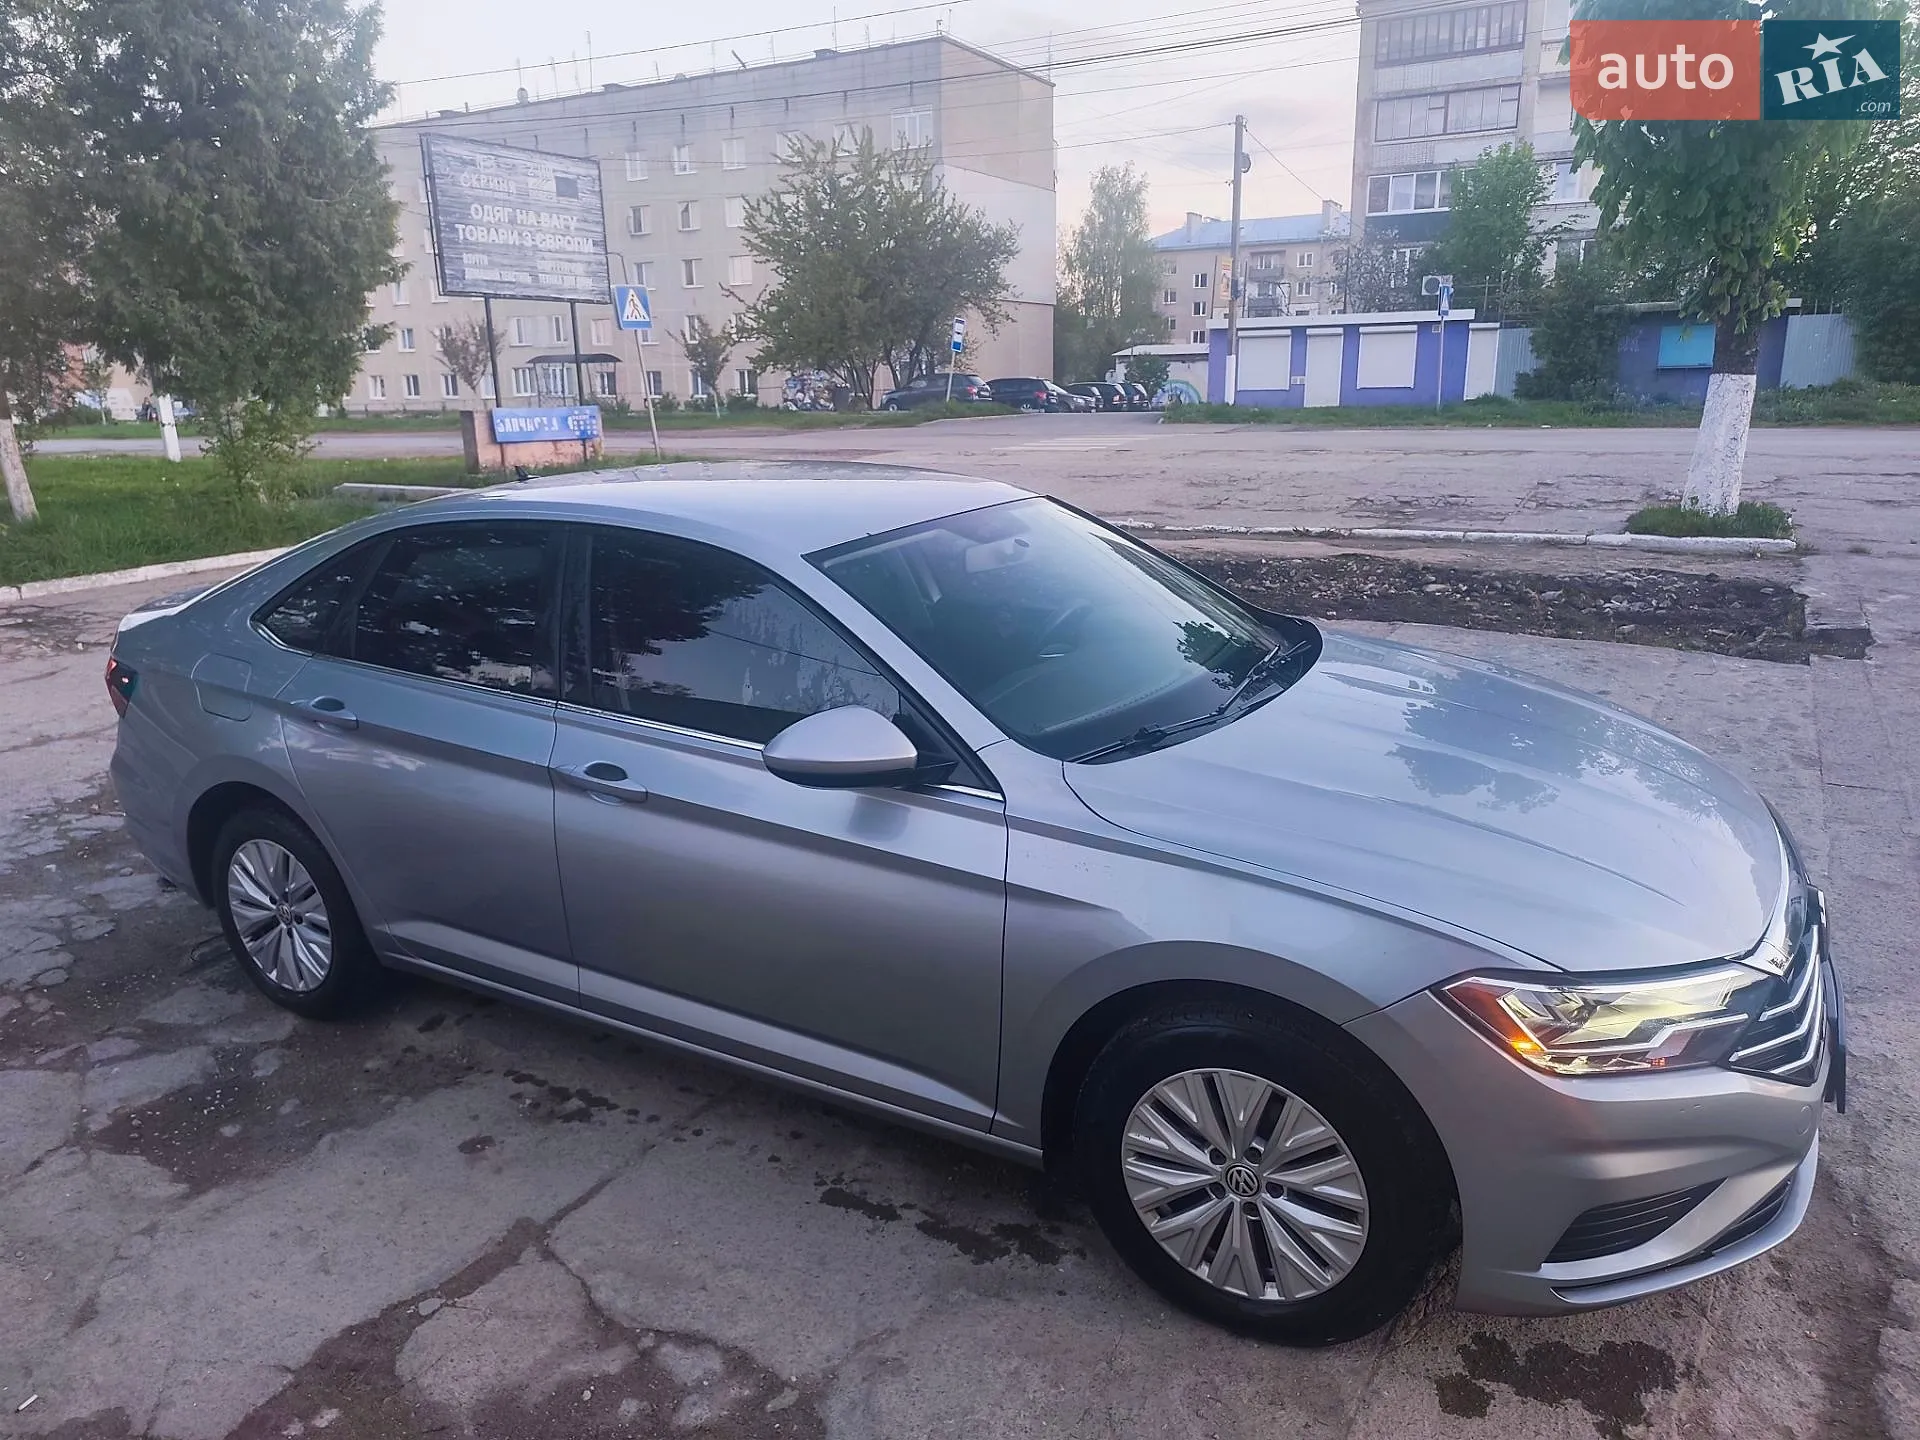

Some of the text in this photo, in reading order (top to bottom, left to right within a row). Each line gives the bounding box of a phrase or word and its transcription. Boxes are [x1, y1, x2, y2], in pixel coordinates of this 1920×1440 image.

[470, 204, 513, 224] ОДЯГ
[516, 208, 537, 226] НА
[455, 223, 520, 245] ТОВАРИ
